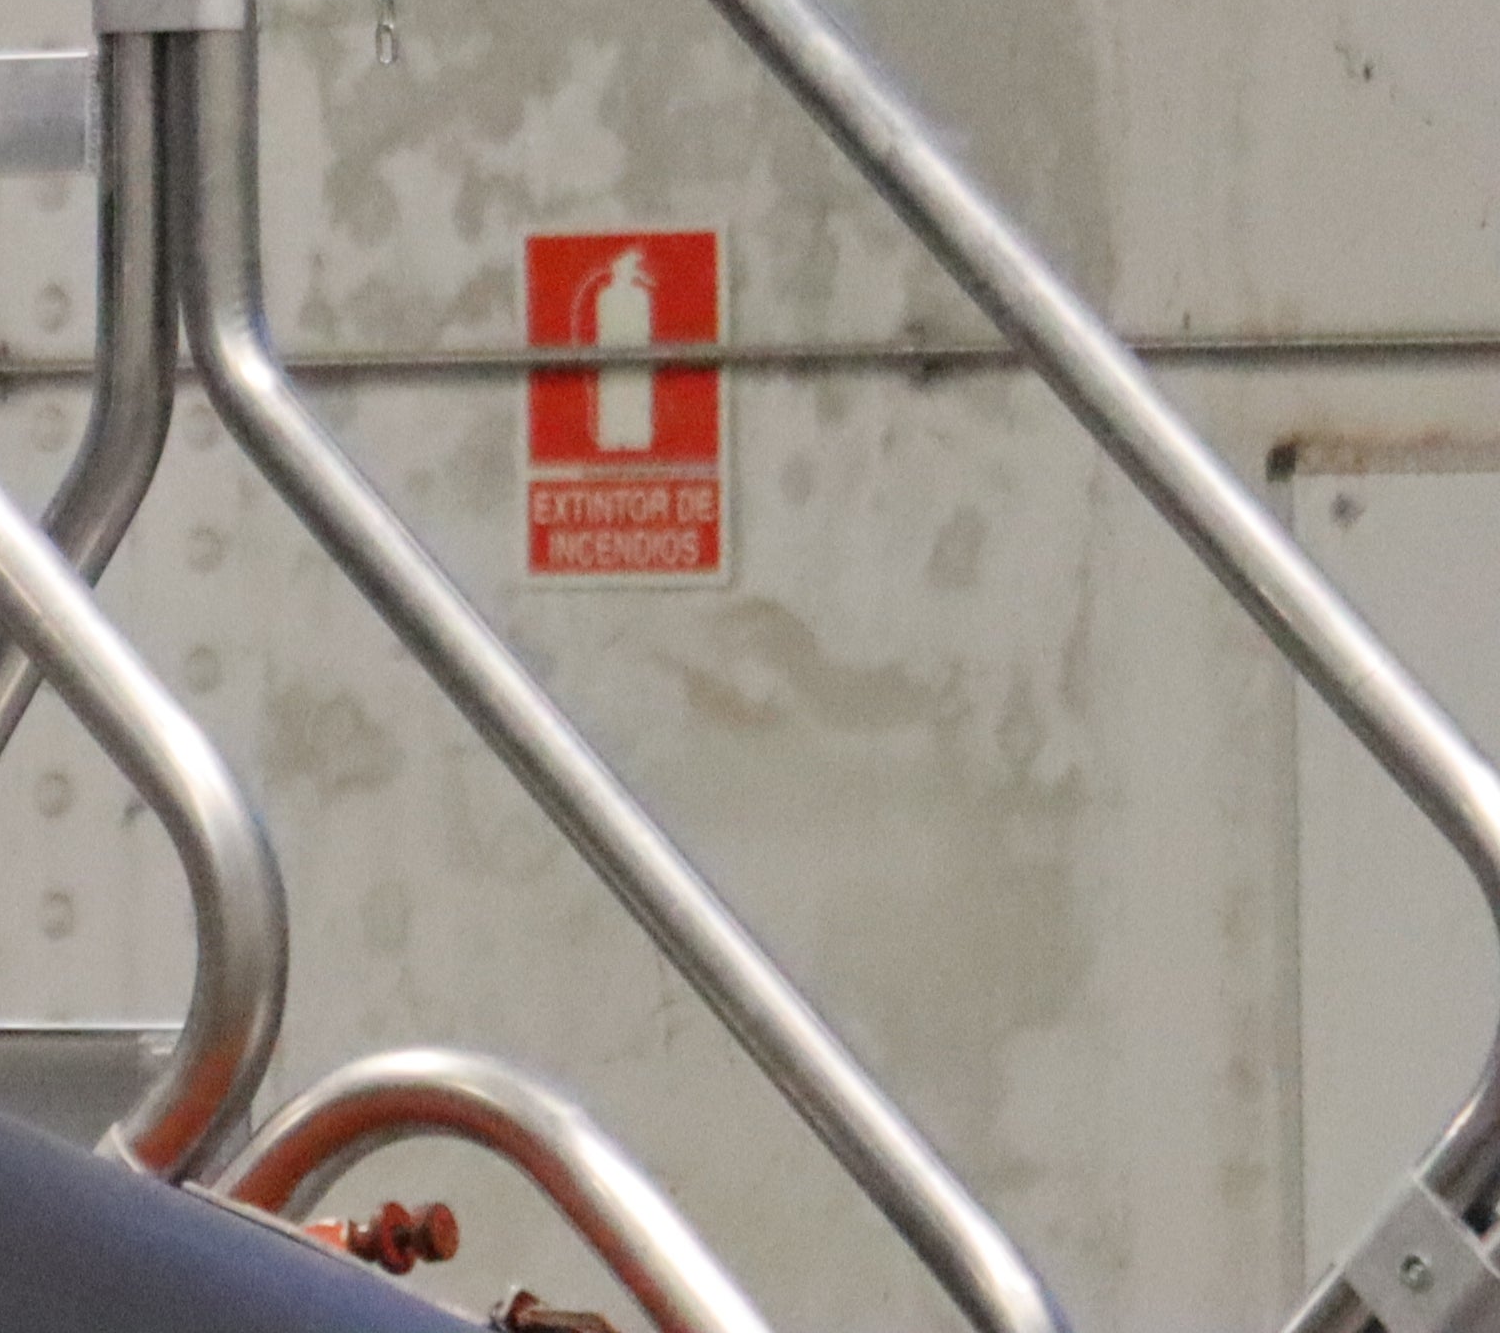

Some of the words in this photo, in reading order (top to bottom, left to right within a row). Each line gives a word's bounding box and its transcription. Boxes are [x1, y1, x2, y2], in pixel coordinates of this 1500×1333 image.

[532, 488, 668, 524] EXTINTOR
[677, 487, 714, 523] DE
[551, 531, 700, 567] INCENDIOS
